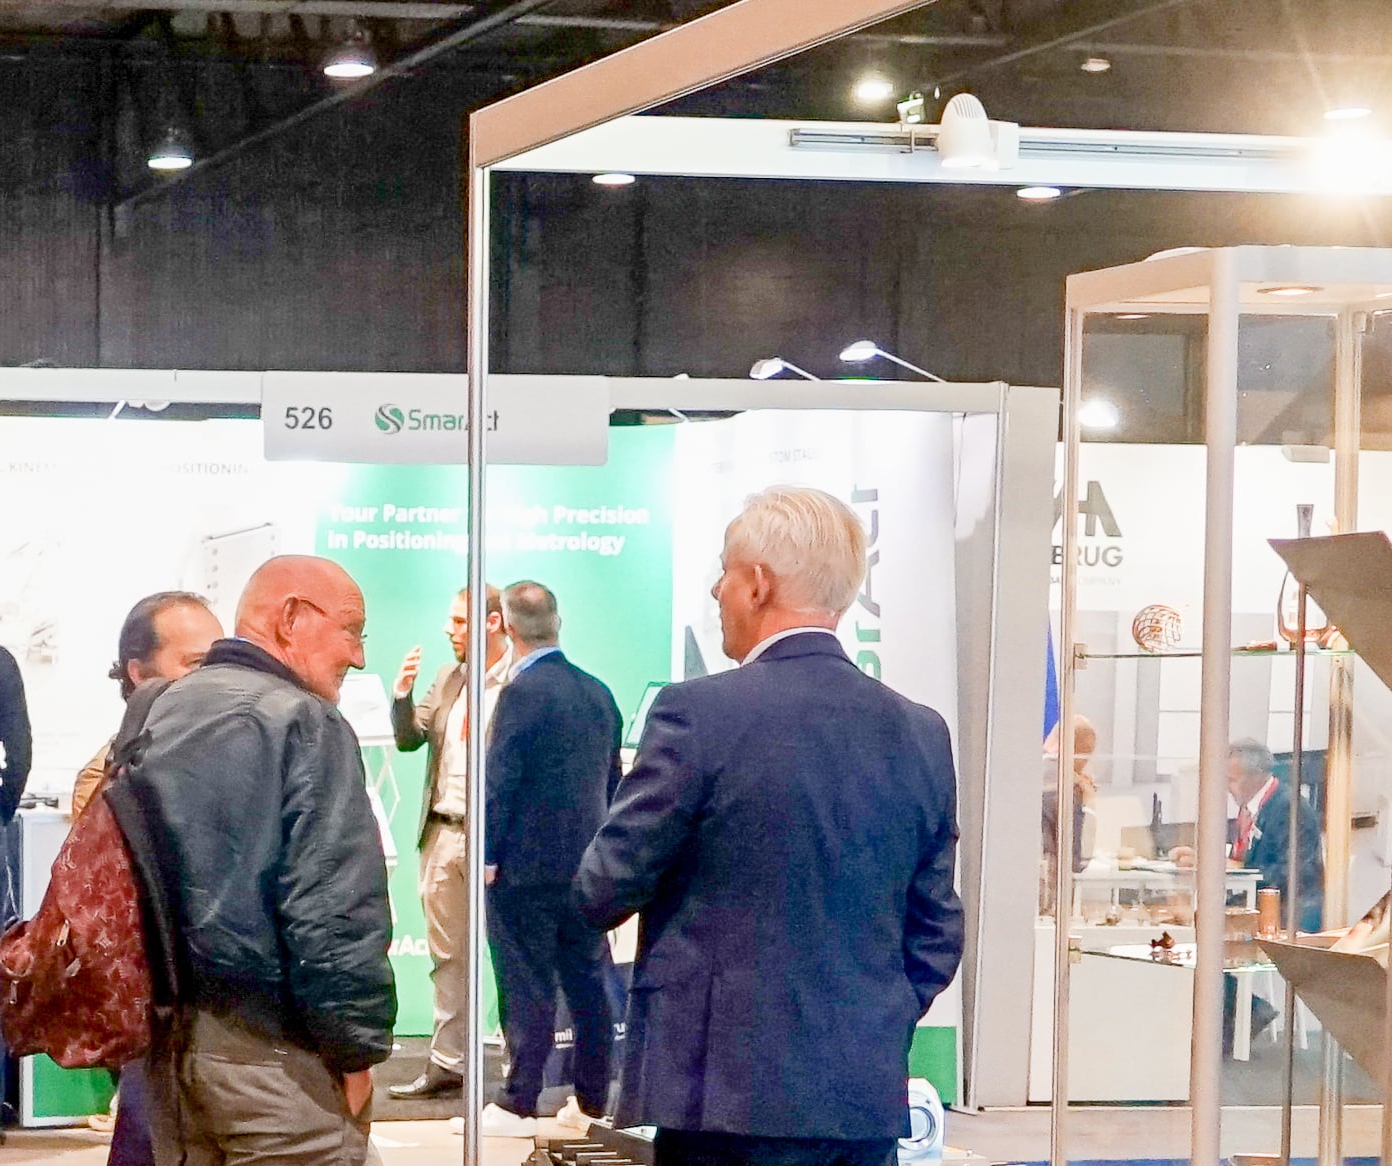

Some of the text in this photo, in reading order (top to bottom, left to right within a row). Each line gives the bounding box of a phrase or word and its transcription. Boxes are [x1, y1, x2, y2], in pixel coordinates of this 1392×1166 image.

[285, 407, 499, 432] 526 Smart
[383, 504, 461, 523] Partner
[553, 505, 649, 524] Precision
